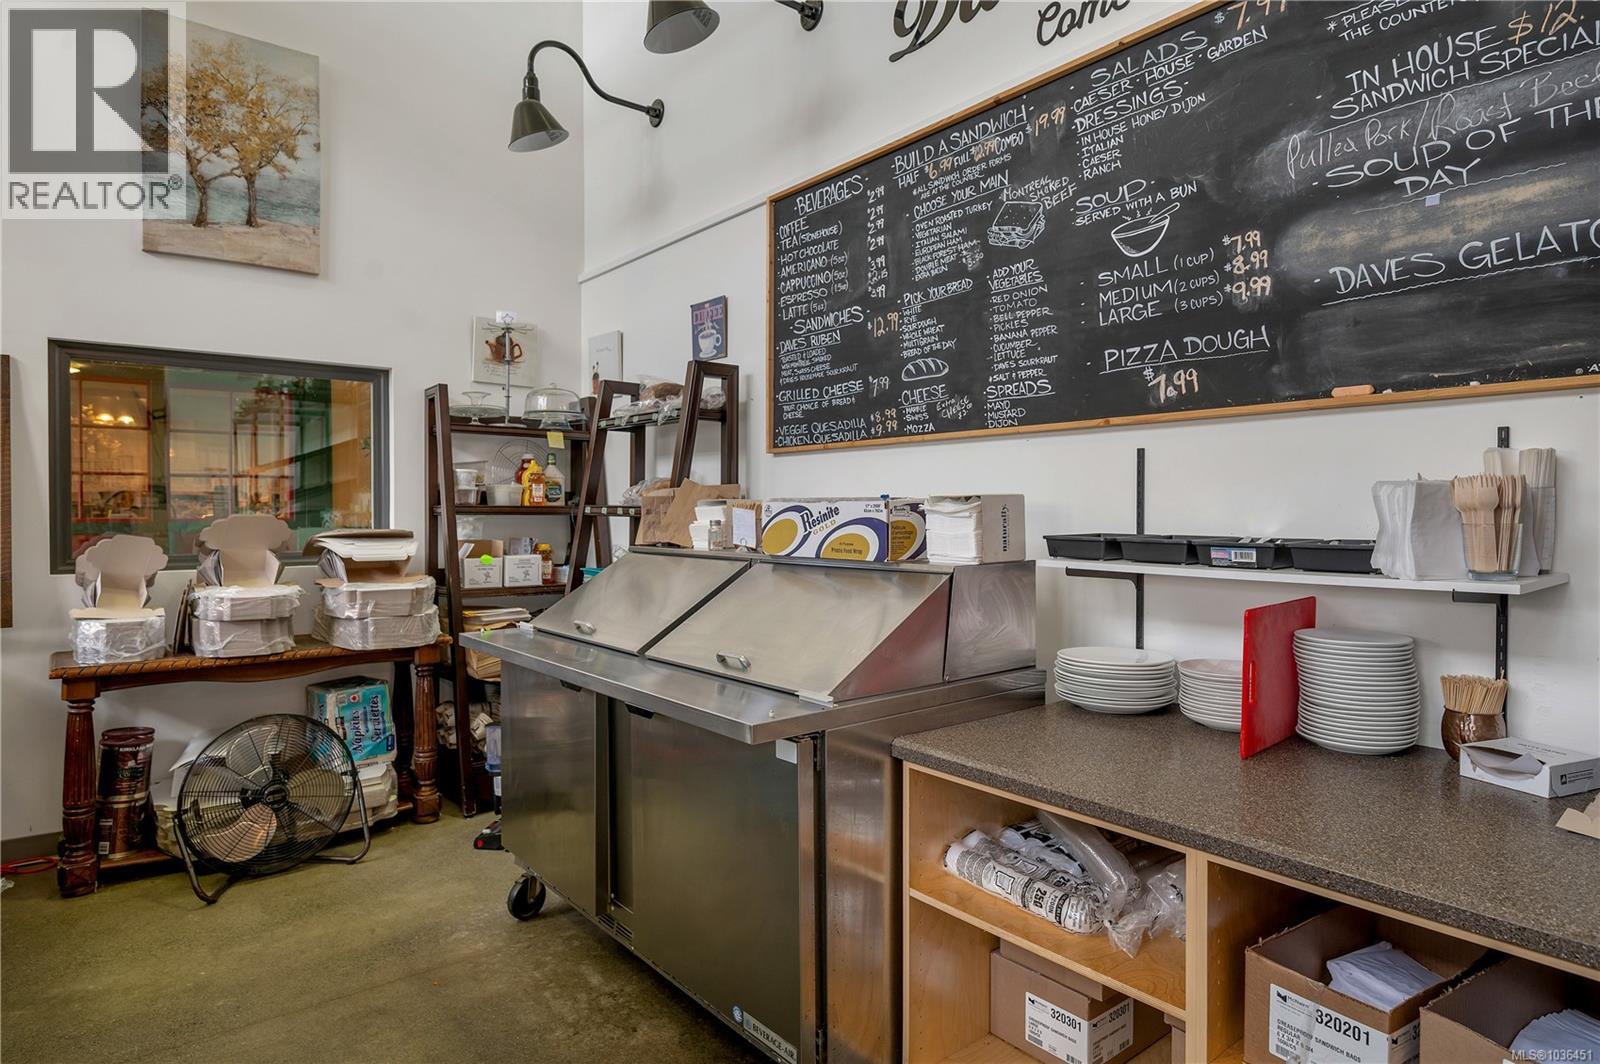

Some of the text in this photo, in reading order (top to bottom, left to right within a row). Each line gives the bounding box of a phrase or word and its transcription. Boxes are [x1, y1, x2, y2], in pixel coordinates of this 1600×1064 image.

[1338, 23, 1375, 42] THE
[1073, 25, 1269, 113] CAESER HOUSE GARDEN
[1090, 30, 1208, 88] SALADS
[1345, 25, 1504, 96] IN HOUSE
[1329, 60, 1470, 120] SANDWICH
[1074, 80, 1183, 133] DRESSINGS
[1081, 92, 1205, 146] IN HOUSE HONEY DIJON
[894, 104, 1028, 174] BUILD A SANDWICH
[1081, 134, 1124, 158] ITALIAN
[899, 170, 920, 189] HALF
[953, 152, 972, 168] FULL
[994, 131, 1024, 155] COMBO
[1082, 149, 1122, 168] CAESER
[1325, 140, 1451, 188] SOUP
[1466, 117, 1521, 151] OF
[1083, 160, 1121, 180] RANCH
[1393, 157, 1482, 198] DAY
[796, 174, 864, 216] BEVERAGES
[913, 169, 1009, 219] CHOOSE YOUR MAIN
[1003, 175, 1051, 202] MONTREAL
[1041, 182, 1077, 210] BEEF
[1076, 179, 1147, 214] SOUP
[1075, 181, 1197, 226] SERVED WITH A BUN
[915, 200, 993, 232] OVEN ROASTED TURKEY
[779, 216, 810, 240] COFFEE
[915, 226, 968, 249] ITALIAN SALAMI
[780, 234, 799, 251] TEA
[780, 240, 839, 265] HOT CHOCOLATE
[915, 236, 963, 257] EUROPEAN HAM
[780, 255, 828, 279] AMERICANO
[992, 259, 1039, 280] ADD YOUR
[1097, 256, 1169, 287] SMALL
[1222, 230, 1262, 254] $7.99
[780, 270, 831, 294] CAPPUCCINO
[988, 270, 1043, 290] VEGETABLES
[1099, 280, 1173, 309] MEDIUM
[1189, 270, 1220, 290] CUPS)
[1224, 249, 1268, 275] $8.99
[1328, 252, 1446, 295] DAVES
[780, 287, 828, 307] ESPRESSO
[903, 278, 973, 306] PICK YOUR BREAD
[992, 284, 1048, 304] RED ONION
[1099, 300, 1163, 327] LARGE
[1190, 290, 1223, 308] CUPS)
[1224, 274, 1272, 301] $9.99
[782, 304, 809, 321] LATTE
[903, 305, 922, 316] WHITE
[992, 297, 1037, 313] TOMATO
[993, 306, 1054, 324] BELL PEPPER
[793, 306, 864, 334] SANDWICHES
[923, 324, 945, 336] WHEAT
[993, 319, 1029, 332] PICKLES
[780, 330, 841, 355] DAVES RUBEN
[993, 324, 1058, 343] BANANA PEPPER
[903, 348, 922, 359] BREAD
[942, 338, 957, 350] DAY
[993, 339, 1038, 353] CUCUMBER
[993, 349, 1026, 362] LETTUCE
[1104, 324, 1271, 371] PIZZA DOUGH
[994, 354, 1058, 371] DAVES SOURKRAUT
[993, 372, 1010, 382] SALT
[1017, 368, 1047, 379] PEPPER
[778, 379, 865, 402] GRILLED CHEESE
[902, 384, 946, 406] CHEESE
[986, 379, 1052, 399] SPREADS
[796, 401, 819, 412] CHOICE
[906, 412, 930, 422] SWISS
[987, 400, 1011, 411] MAYO
[987, 407, 1026, 420] MUSTARD
[778, 423, 809, 436] VEGGIE
[811, 418, 867, 434] QUESADILLA
[906, 422, 936, 434] MOZZA
[987, 418, 1018, 429] DIJON
[777, 435, 812, 447] CHICKEN
[812, 429, 868, 445] QUESADILLA
[800, 505, 840, 533] Resinite
[813, 520, 837, 536] GOLD
[351, 710, 365, 753] Napkins
[1050, 1008, 1082, 1033] 320301
[1109, 1002, 1130, 1024] 320301
[1315, 1008, 1371, 1047] 320201
